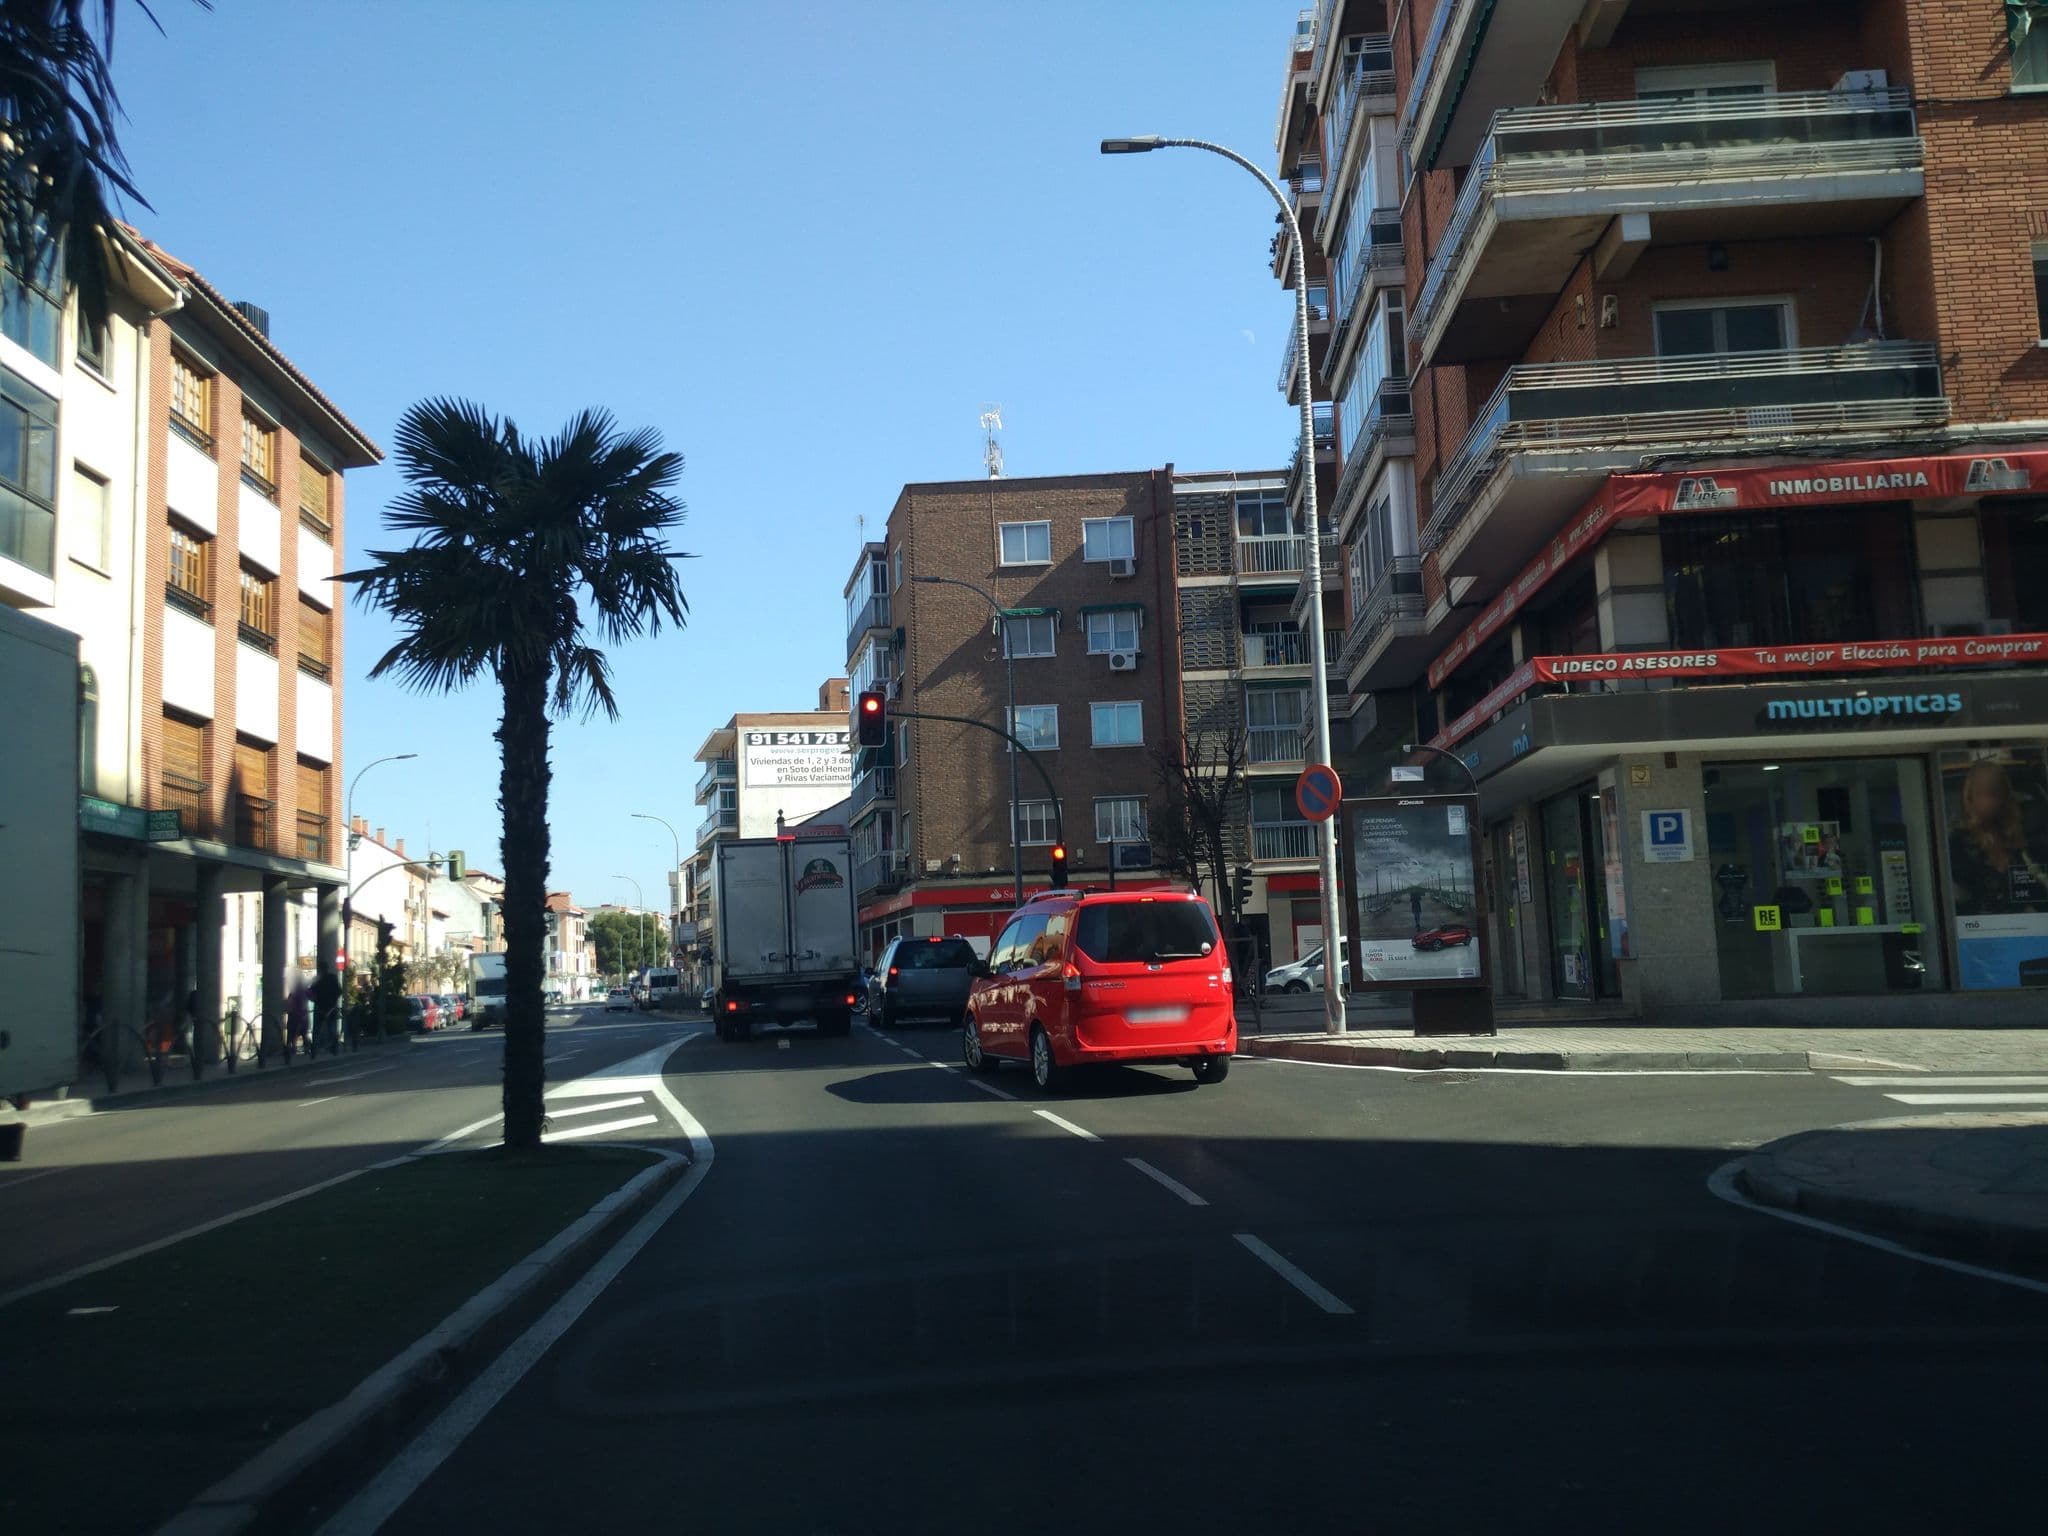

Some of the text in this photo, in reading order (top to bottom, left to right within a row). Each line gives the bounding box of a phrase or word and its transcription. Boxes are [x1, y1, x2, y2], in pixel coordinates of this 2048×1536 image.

[1769, 471, 1929, 496] INMOBILIARIA
[1754, 640, 2042, 666] Tu mejor Elección para Comprar
[1551, 654, 1718, 674] LIDECO ASESORES
[750, 733, 772, 745] 91
[777, 733, 809, 745] 541
[815, 733, 838, 745] 78
[750, 757, 792, 765] Viviendas
[793, 757, 805, 765] de
[823, 758, 829, 766] y
[789, 765, 809, 773] Soto
[811, 765, 824, 773] del
[777, 775, 783, 783] y
[785, 774, 808, 782] Rivas
[1658, 816, 1678, 841] P
[1759, 910, 1776, 922] RE
